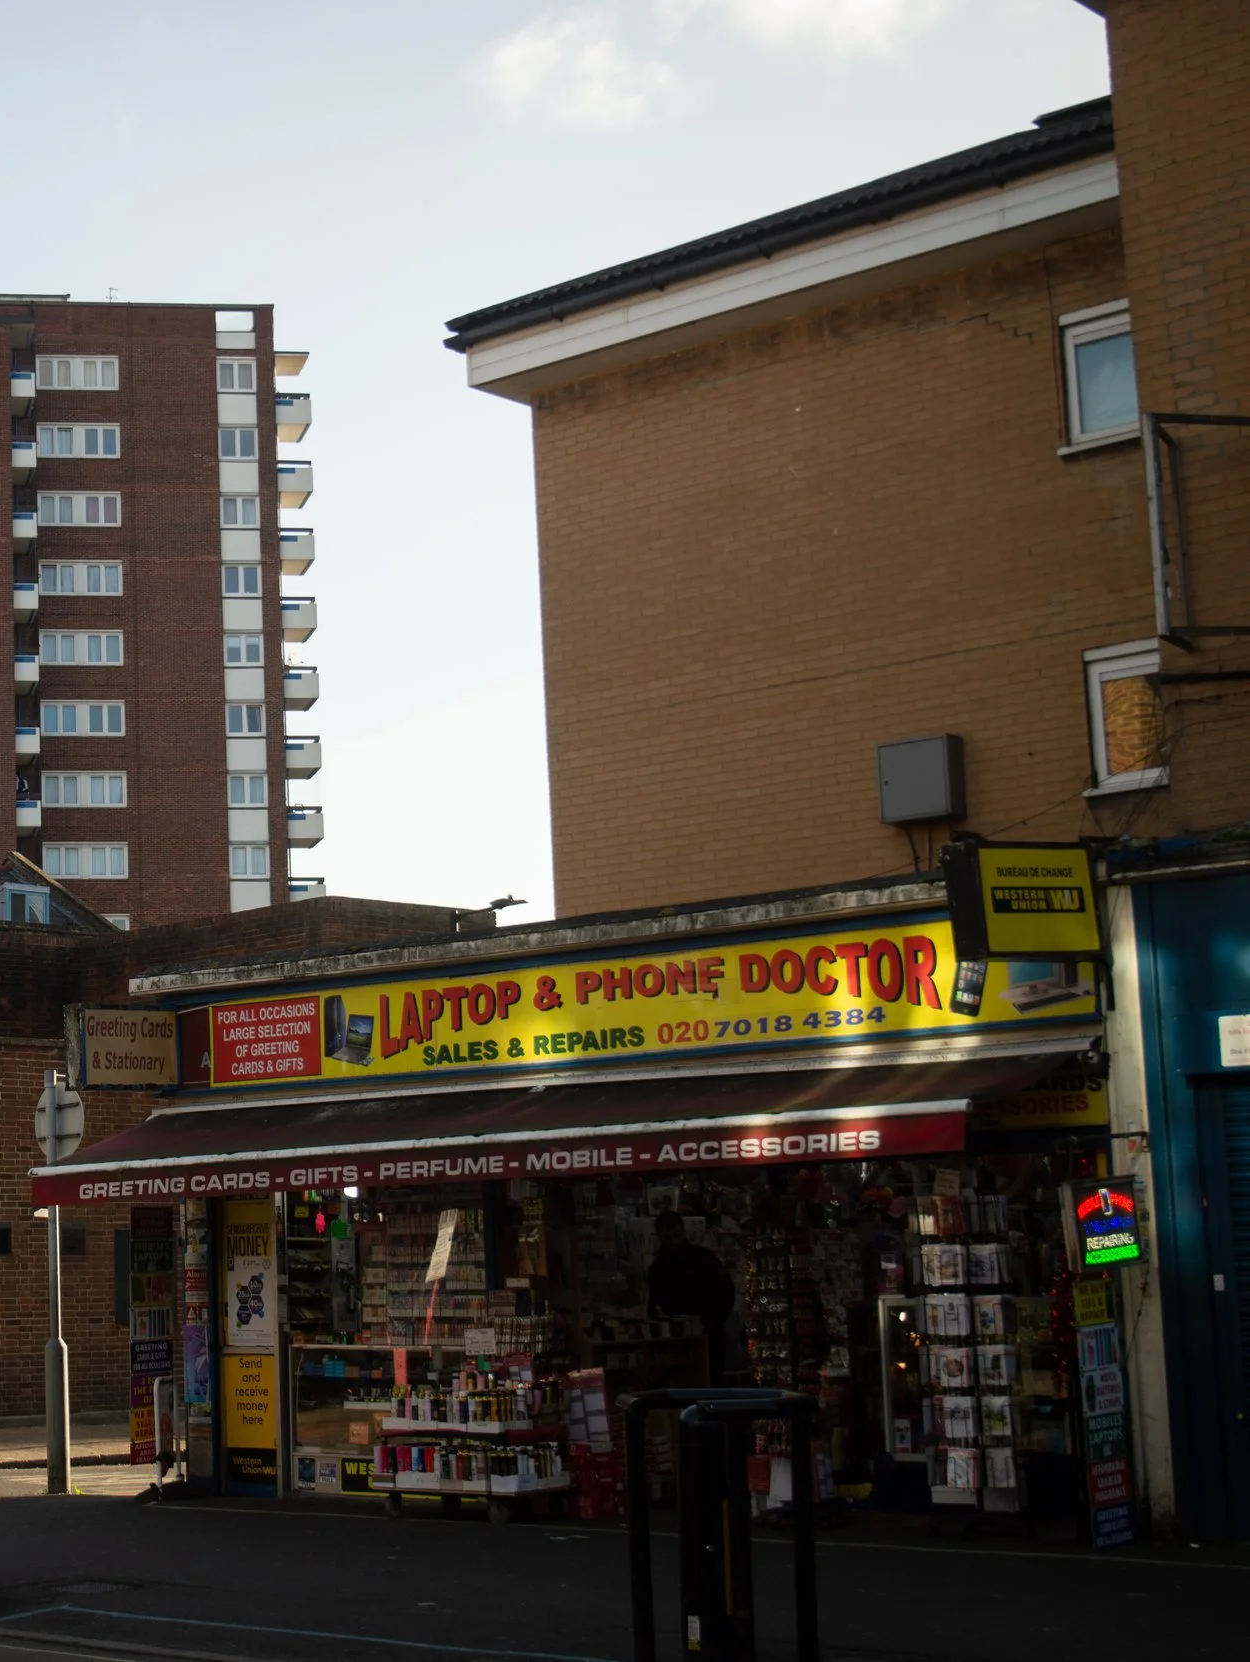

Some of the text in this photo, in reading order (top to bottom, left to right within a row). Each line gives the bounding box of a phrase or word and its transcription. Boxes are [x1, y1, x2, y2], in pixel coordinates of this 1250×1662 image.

[996, 866, 1073, 878] BUREAU DE CHANGE
[993, 889, 1046, 900] WESTERN
[1011, 900, 1047, 910] UNION
[379, 935, 942, 1059] LAPTOP & PHONE DOCTOR
[217, 1003, 315, 1025] FOR ALL OCCASIONS
[86, 1016, 174, 1042] Greeting Cards
[223, 1021, 311, 1042] LARGE SELECTION
[658, 1005, 886, 1044] 020 7018 4384
[235, 1040, 300, 1058] OF GREETING
[422, 1025, 645, 1066] SALES & REPAIRS
[92, 1051, 165, 1075] & Stationary
[231, 1057, 304, 1076] CARDS & GIFTS
[79, 1177, 185, 1200] GREETING
[190, 1172, 270, 1193] CARDS
[290, 1165, 358, 1186] GIFTS
[379, 1155, 504, 1181] PERFUME
[526, 1146, 632, 1172] MOBILE
[657, 1130, 881, 1163] ACCESSORIES
[227, 1236, 269, 1257] MONEY
[1086, 1233, 1135, 1251] REPAIRING
[186, 1270, 207, 1278] Alarm
[135, 1342, 168, 1352] GREETING
[239, 1358, 263, 1369] Send
[242, 1372, 261, 1383] and
[134, 1387, 146, 1396] THE
[235, 1387, 269, 1397] receive
[134, 1410, 146, 1419] WE
[237, 1402, 268, 1413] money
[242, 1413, 263, 1425] here
[1088, 1414, 1123, 1430] MOBILES
[1090, 1427, 1124, 1445] LAPTOPS
[231, 1455, 262, 1465] Western
[242, 1464, 262, 1474] Union
